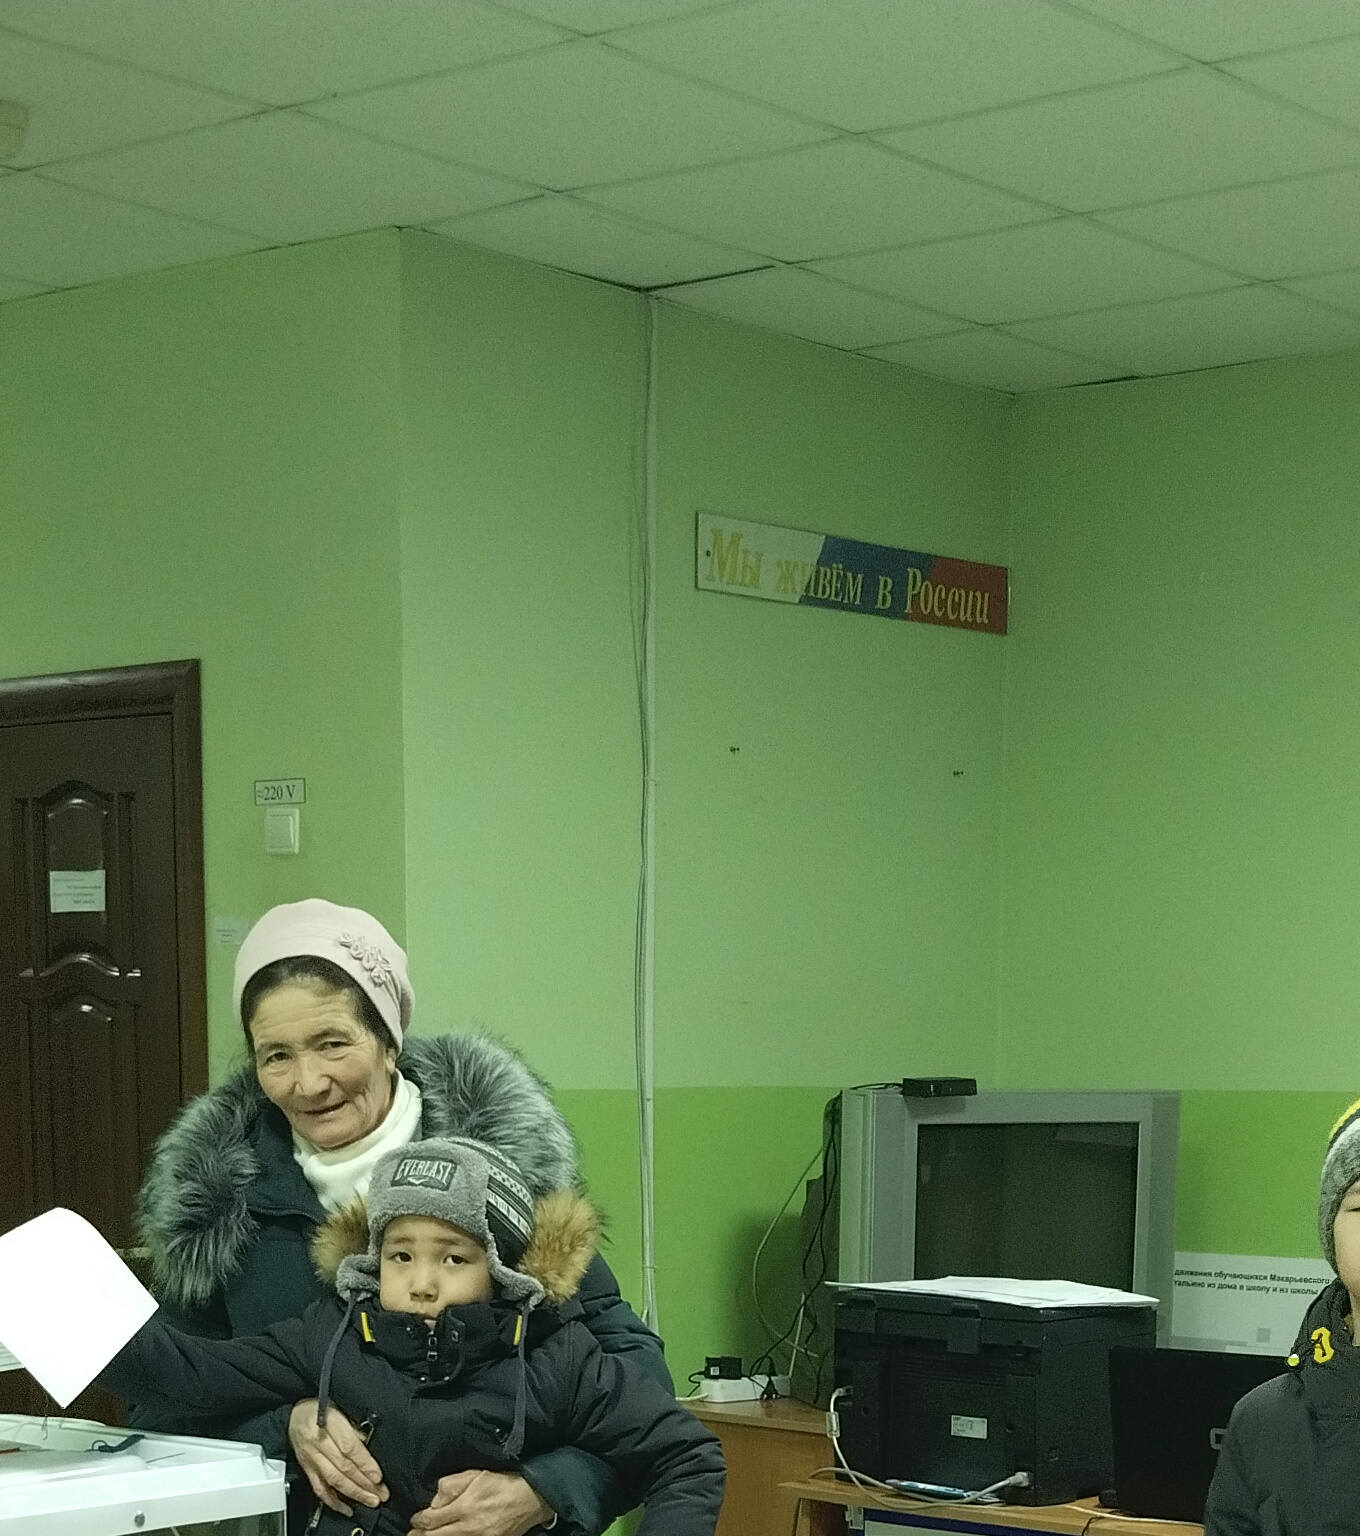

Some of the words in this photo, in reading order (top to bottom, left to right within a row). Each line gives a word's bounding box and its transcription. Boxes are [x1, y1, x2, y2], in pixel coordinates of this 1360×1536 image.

[705, 528, 764, 589] Мы
[774, 562, 863, 606] живём
[876, 576, 893, 610] в
[905, 567, 990, 625] России
[286, 784, 295, 799] V
[395, 1160, 452, 1185] EVERLAST
